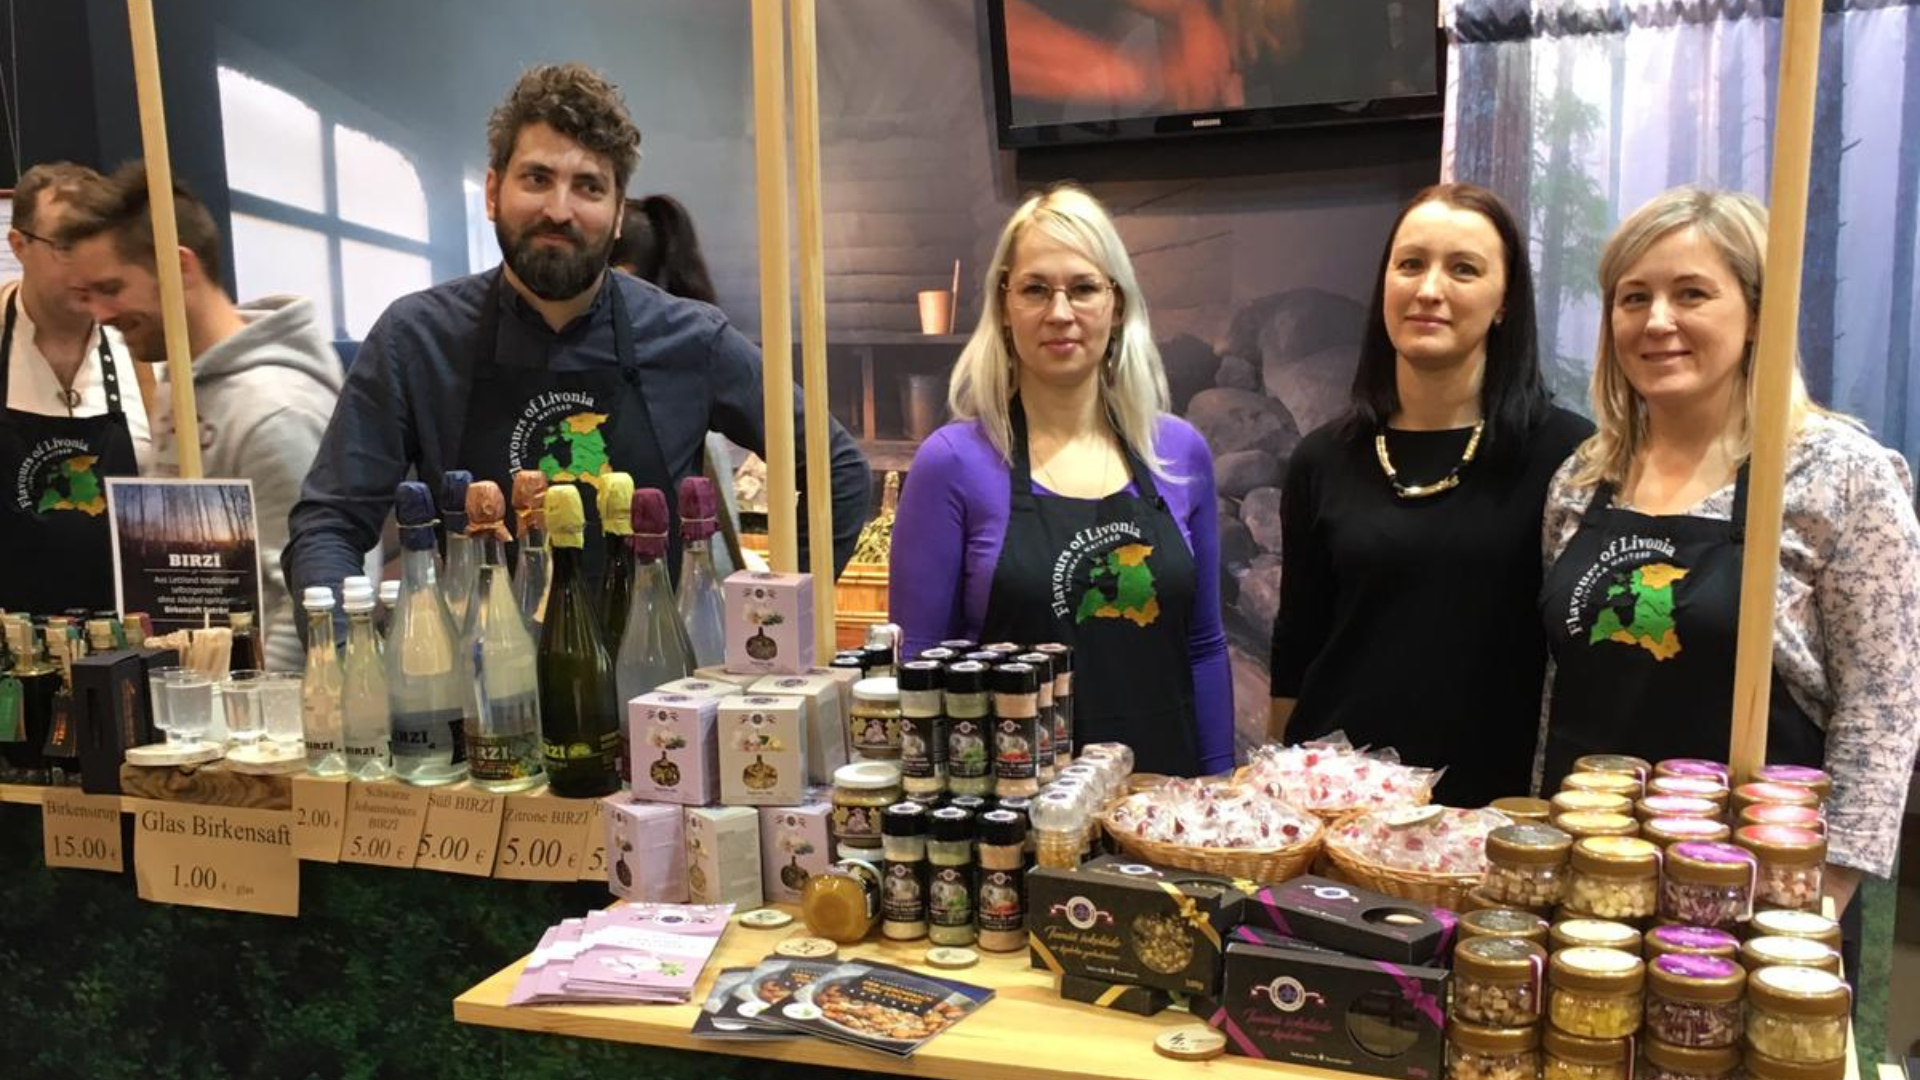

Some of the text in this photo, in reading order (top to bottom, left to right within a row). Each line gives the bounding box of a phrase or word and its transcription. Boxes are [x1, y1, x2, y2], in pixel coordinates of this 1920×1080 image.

[509, 391, 595, 477] lavours of Livonia
[17, 438, 90, 510] Flavours of Livonia
[1051, 521, 1141, 618] Flavours of Livonia
[1566, 535, 1676, 636] Flavours of Livonia
[142, 810, 292, 846] Glas Birkensaft
[297, 808, 331, 828] 2.00
[54, 835, 107, 860] 15.00
[350, 835, 408, 860] 5.00 €
[417, 833, 487, 864] 5.00 €
[503, 838, 579, 868] 5.00 €
[173, 864, 217, 890] 1.00
